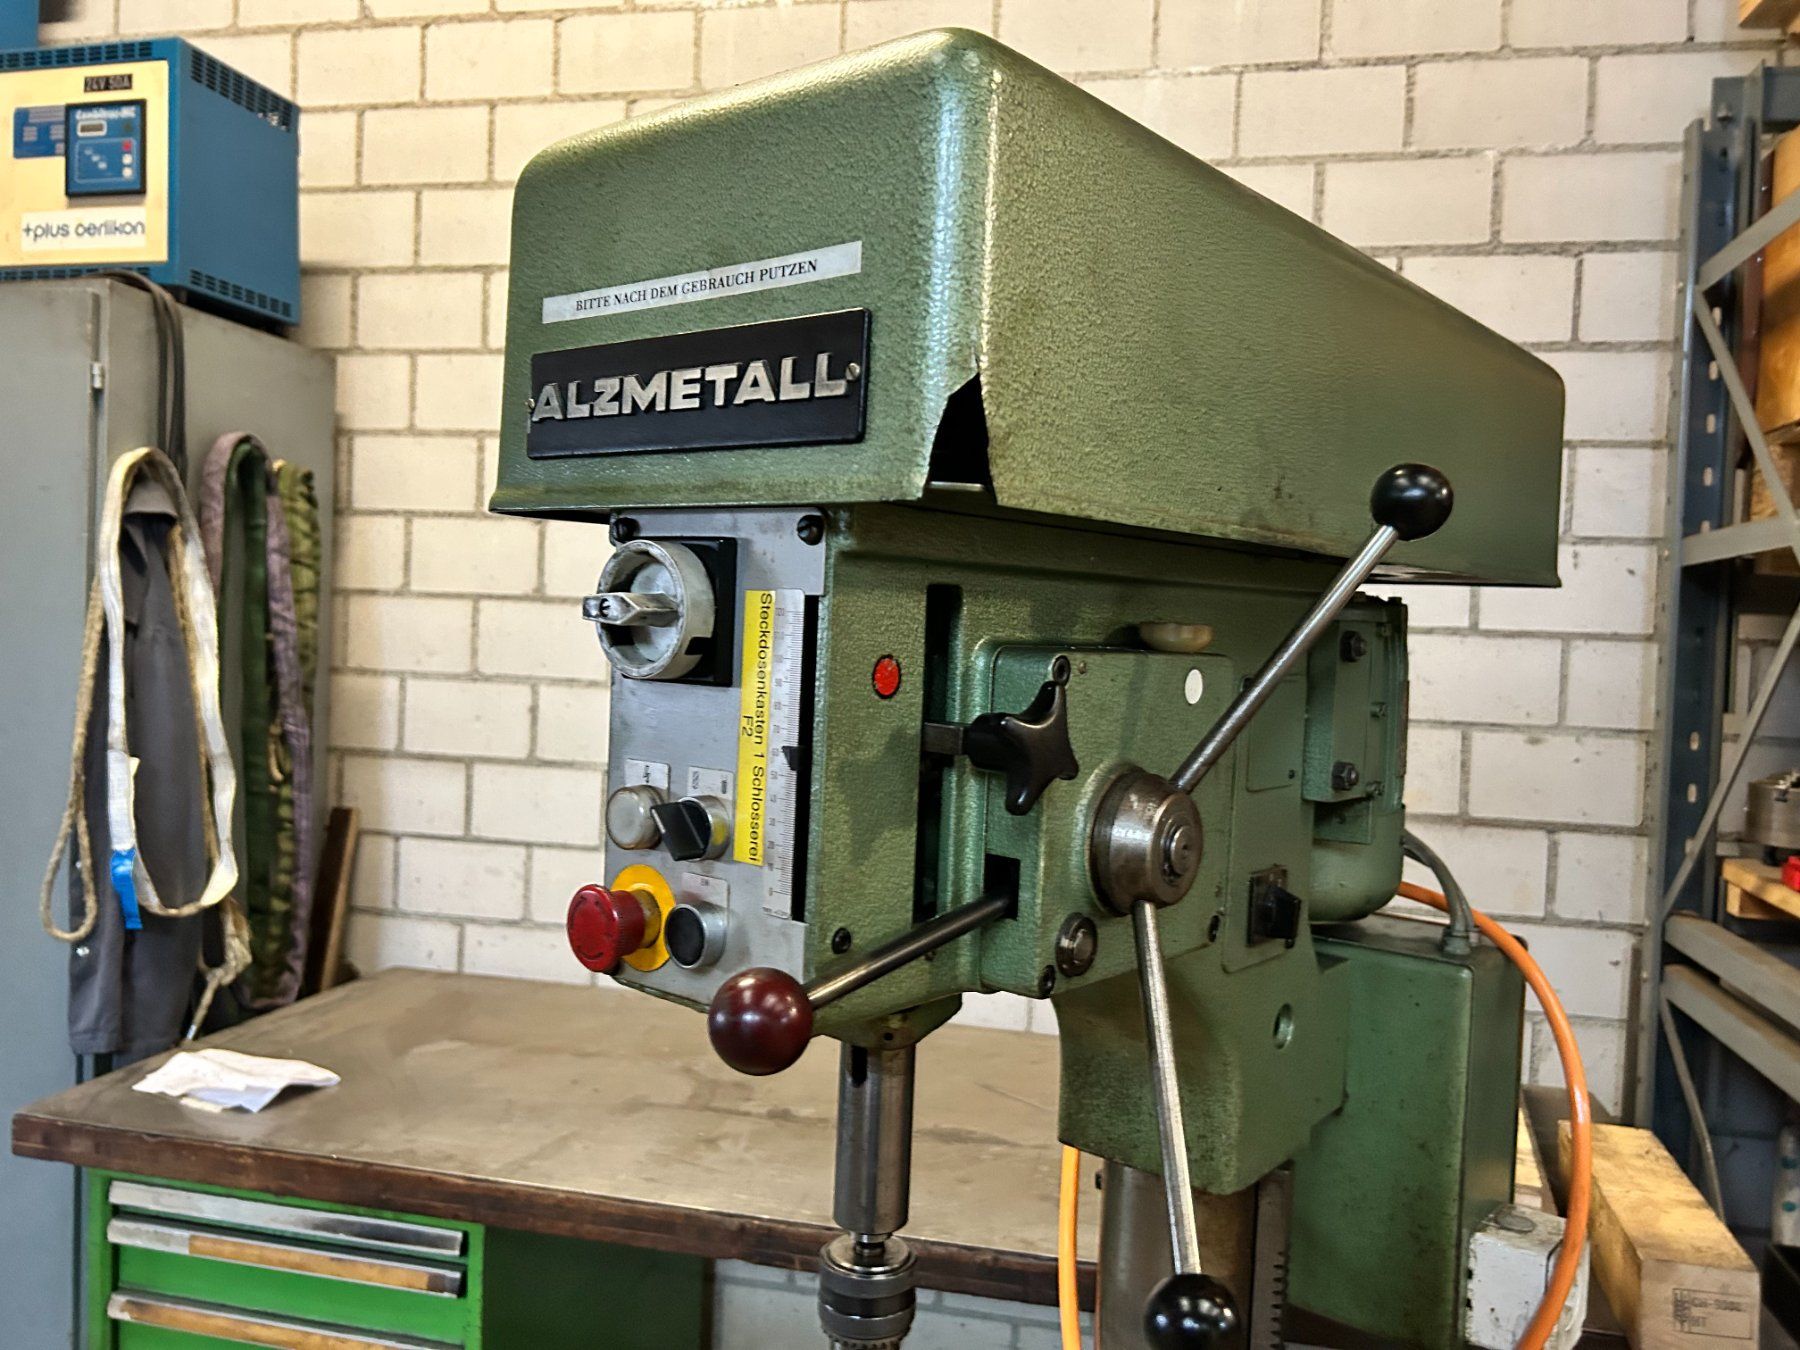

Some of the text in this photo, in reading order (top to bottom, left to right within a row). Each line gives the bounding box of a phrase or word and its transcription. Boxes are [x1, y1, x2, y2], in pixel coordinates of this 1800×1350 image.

[75, 220, 145, 237] oerlikon
[576, 260, 818, 311] BITTE NACH DEM GEBRAUCH PUTZEN
[532, 353, 847, 421] ALZMETALL
[754, 592, 772, 745] Steckdosenkasten
[742, 715, 754, 736] F2
[748, 765, 765, 861] Schlosserei
